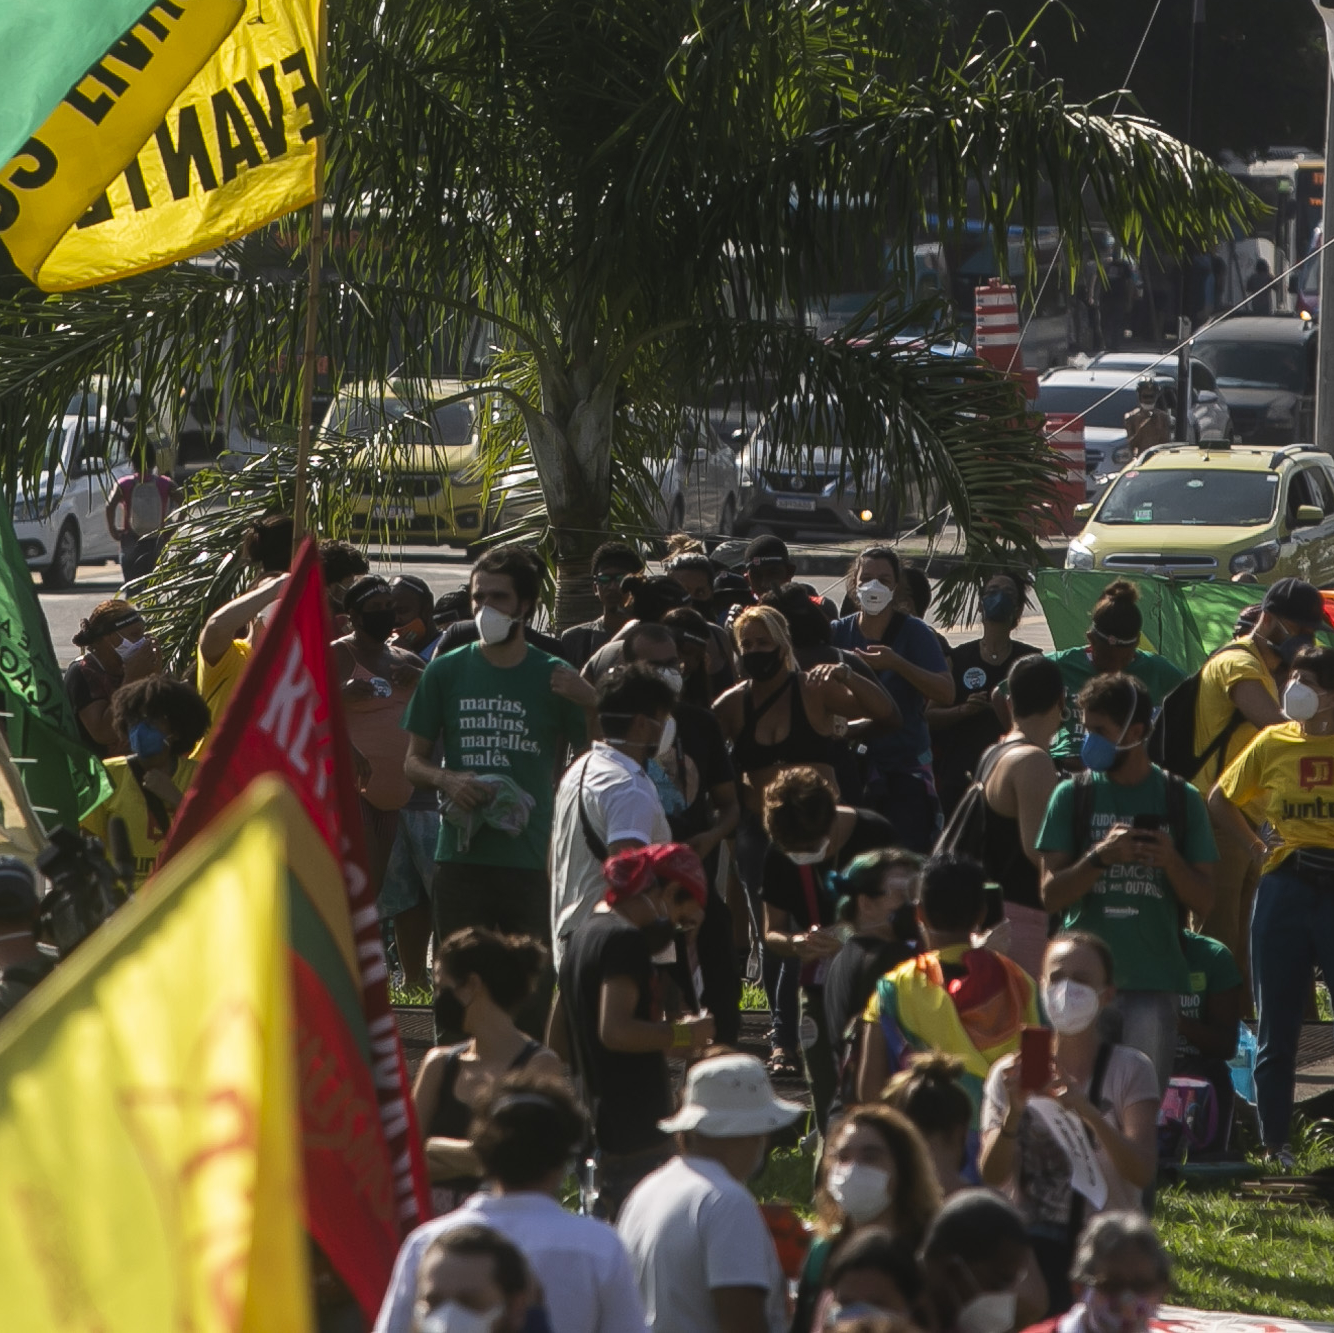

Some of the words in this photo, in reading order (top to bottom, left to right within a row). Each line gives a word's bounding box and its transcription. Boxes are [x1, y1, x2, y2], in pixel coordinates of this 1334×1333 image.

[459, 694, 527, 718] marias,
[459, 712, 530, 739] mahins,
[460, 731, 542, 757] marielles,
